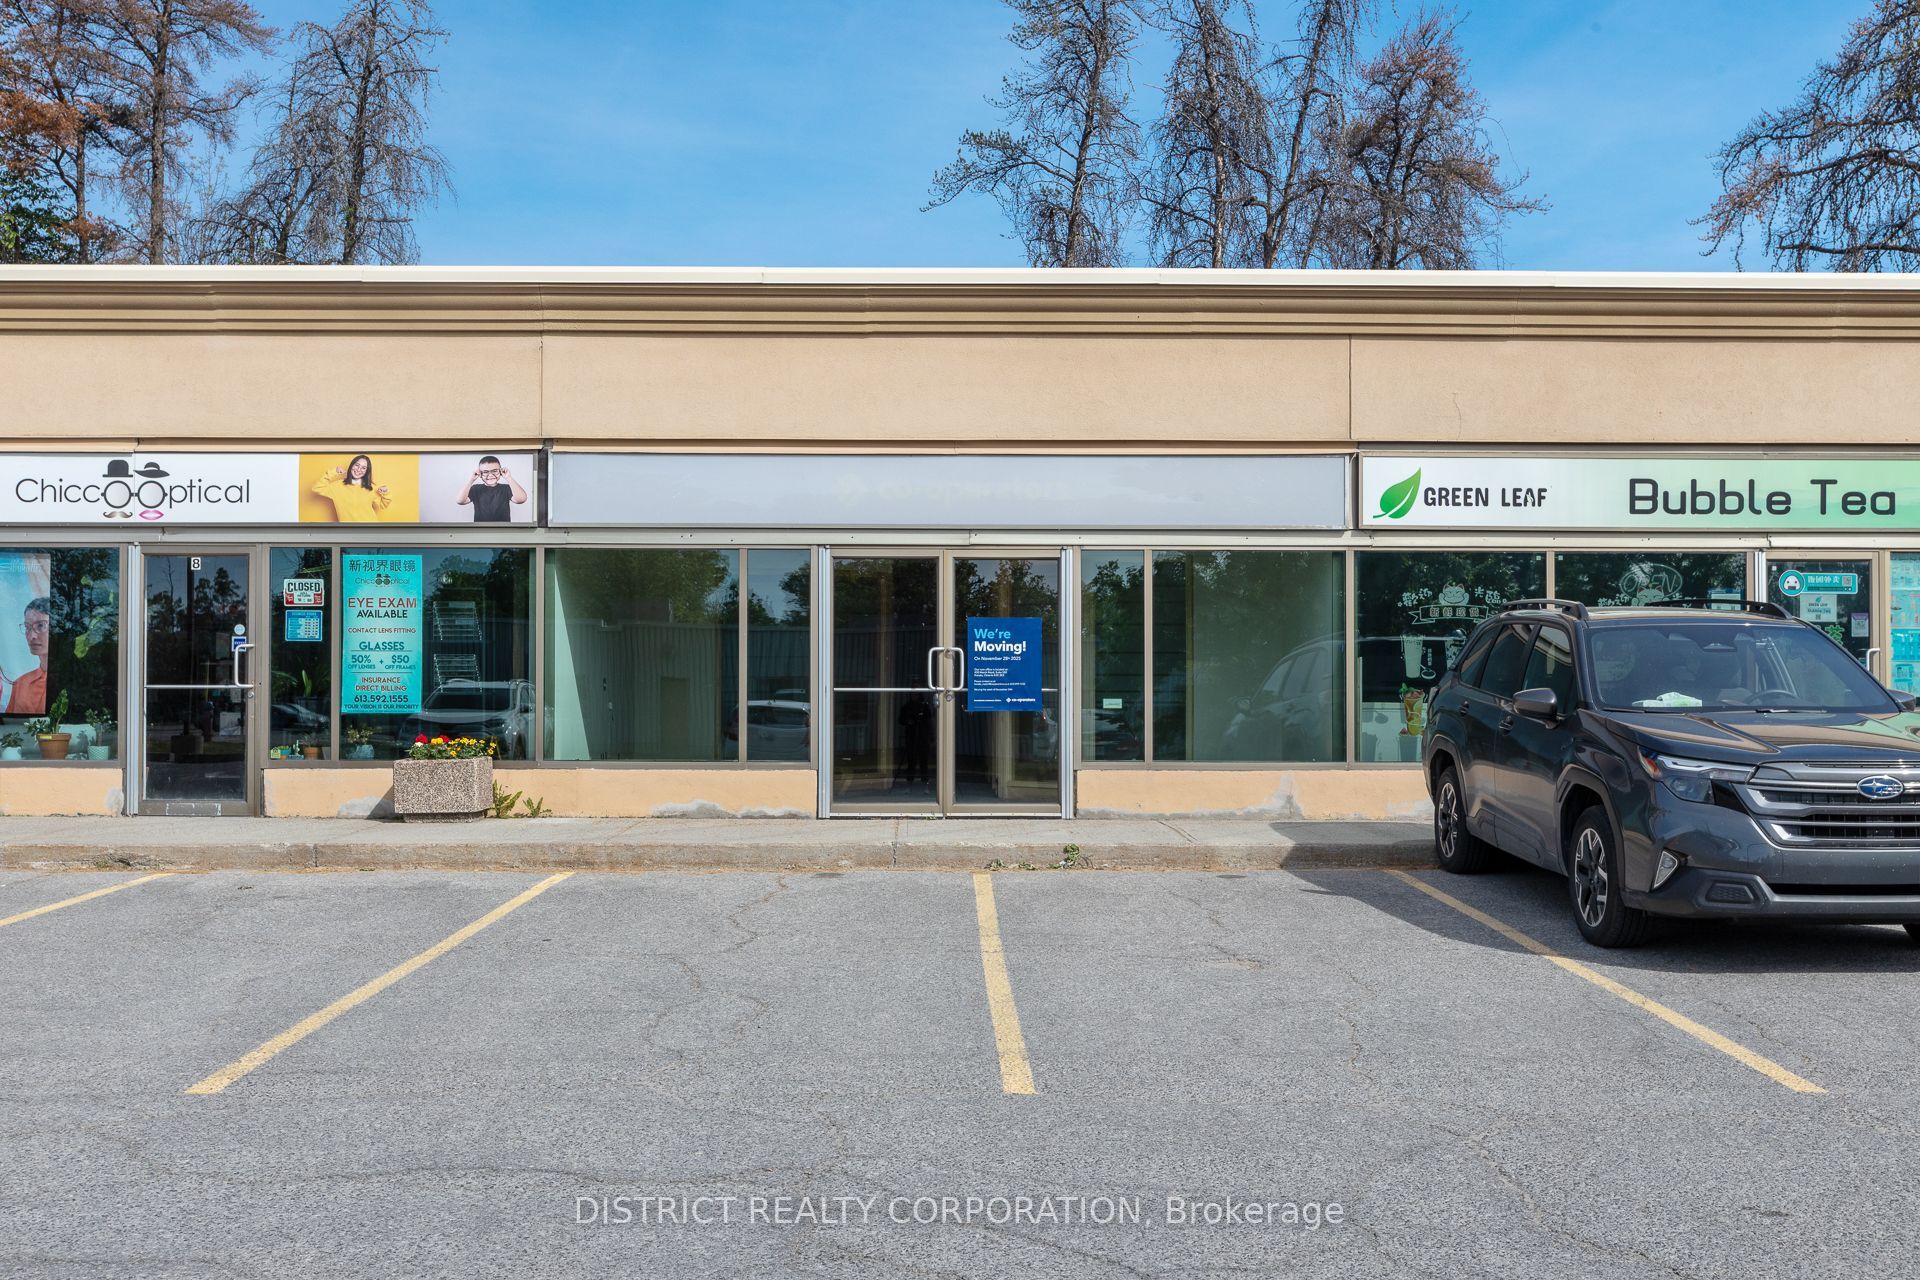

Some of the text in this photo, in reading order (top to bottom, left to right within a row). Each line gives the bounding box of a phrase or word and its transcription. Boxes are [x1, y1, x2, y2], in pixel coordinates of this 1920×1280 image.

[1423, 487, 1548, 507] GREEN LEAF
[1629, 478, 1896, 515] Bubble Tea
[192, 557, 201, 570] 8
[349, 559, 416, 573] 新视界眼镜
[287, 582, 321, 592] CLOSED
[347, 597, 417, 608] EYE EXAM
[356, 609, 408, 619] AVAILABLE
[974, 628, 1011, 639] We're
[358, 641, 405, 650] GLASSES
[974, 640, 1027, 655] Moving!
[351, 654, 372, 664] 50%
[391, 654, 410, 665] $50
[354, 694, 409, 703] 613.592.1555
